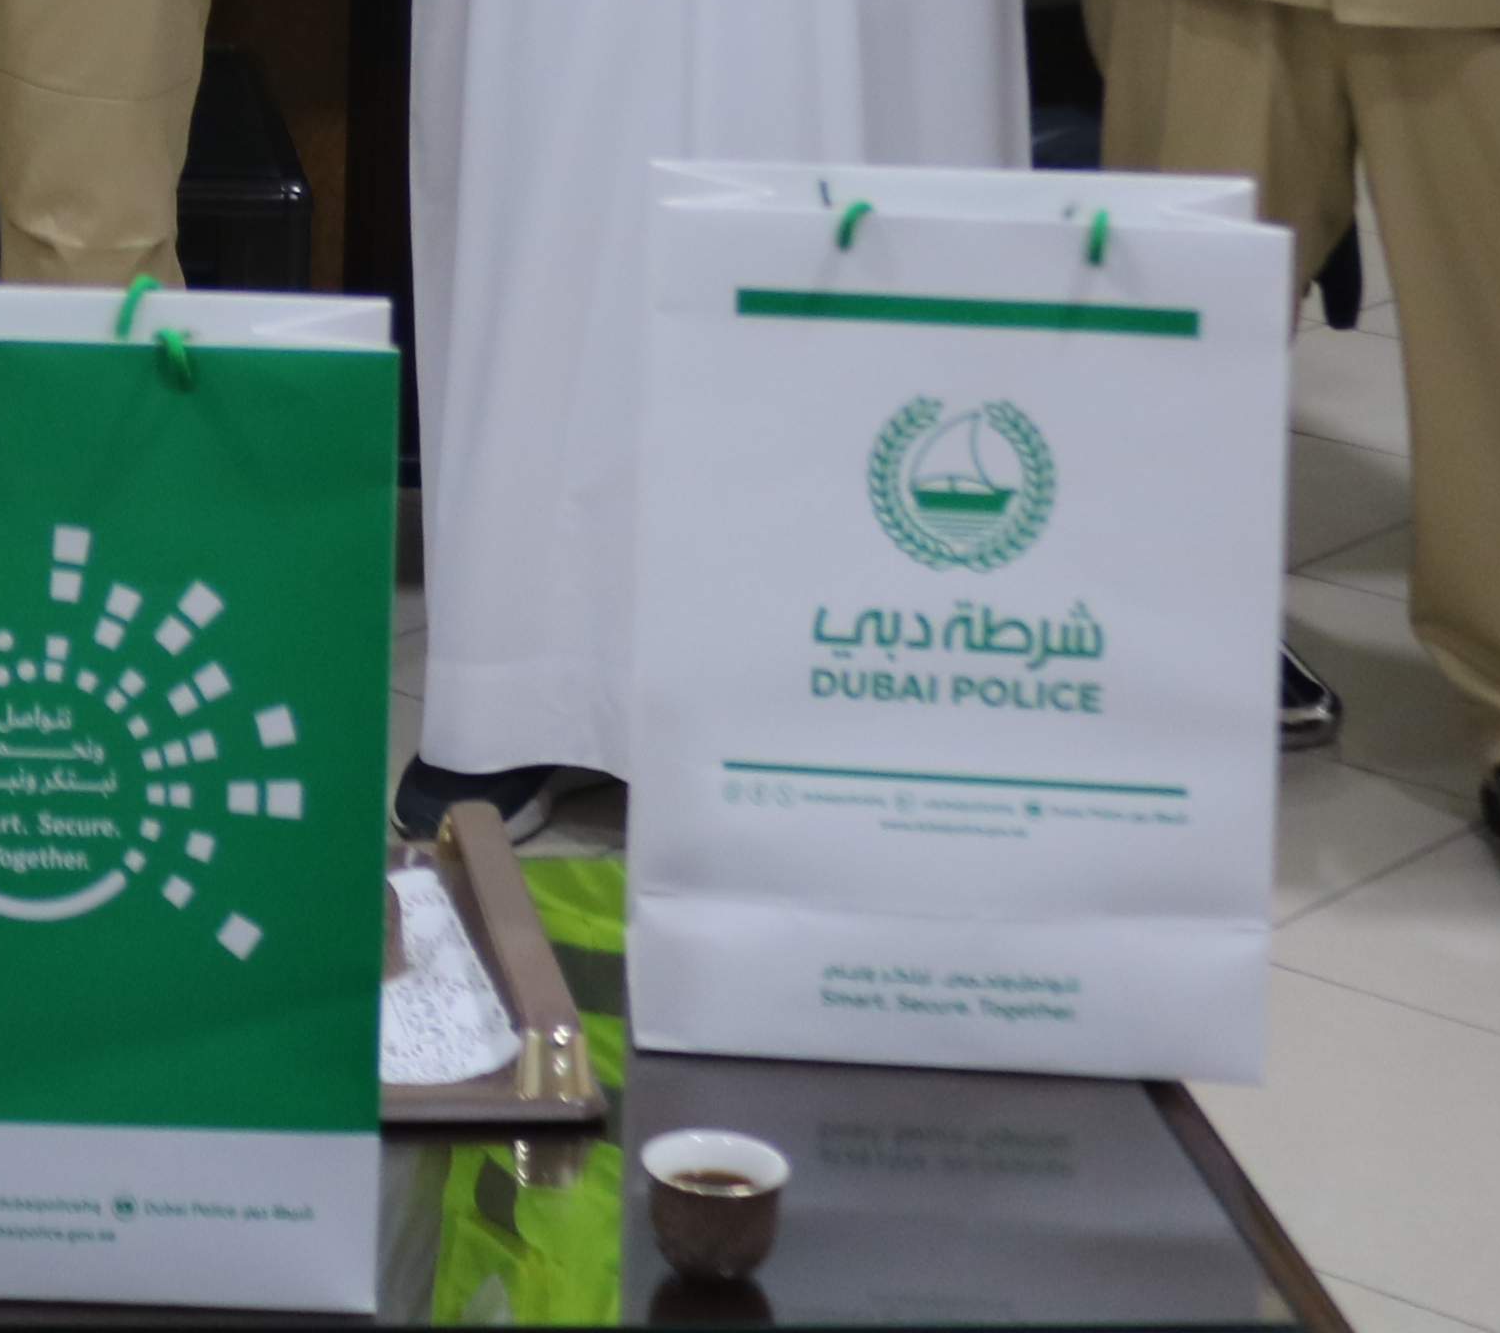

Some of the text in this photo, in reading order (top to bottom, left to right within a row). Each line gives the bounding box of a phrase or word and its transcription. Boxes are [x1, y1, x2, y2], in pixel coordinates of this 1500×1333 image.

[813, 599, 1105, 671] شرطة دبي
[810, 667, 1103, 714] DUBAI POLICE
[37, 810, 122, 839] Secure.
